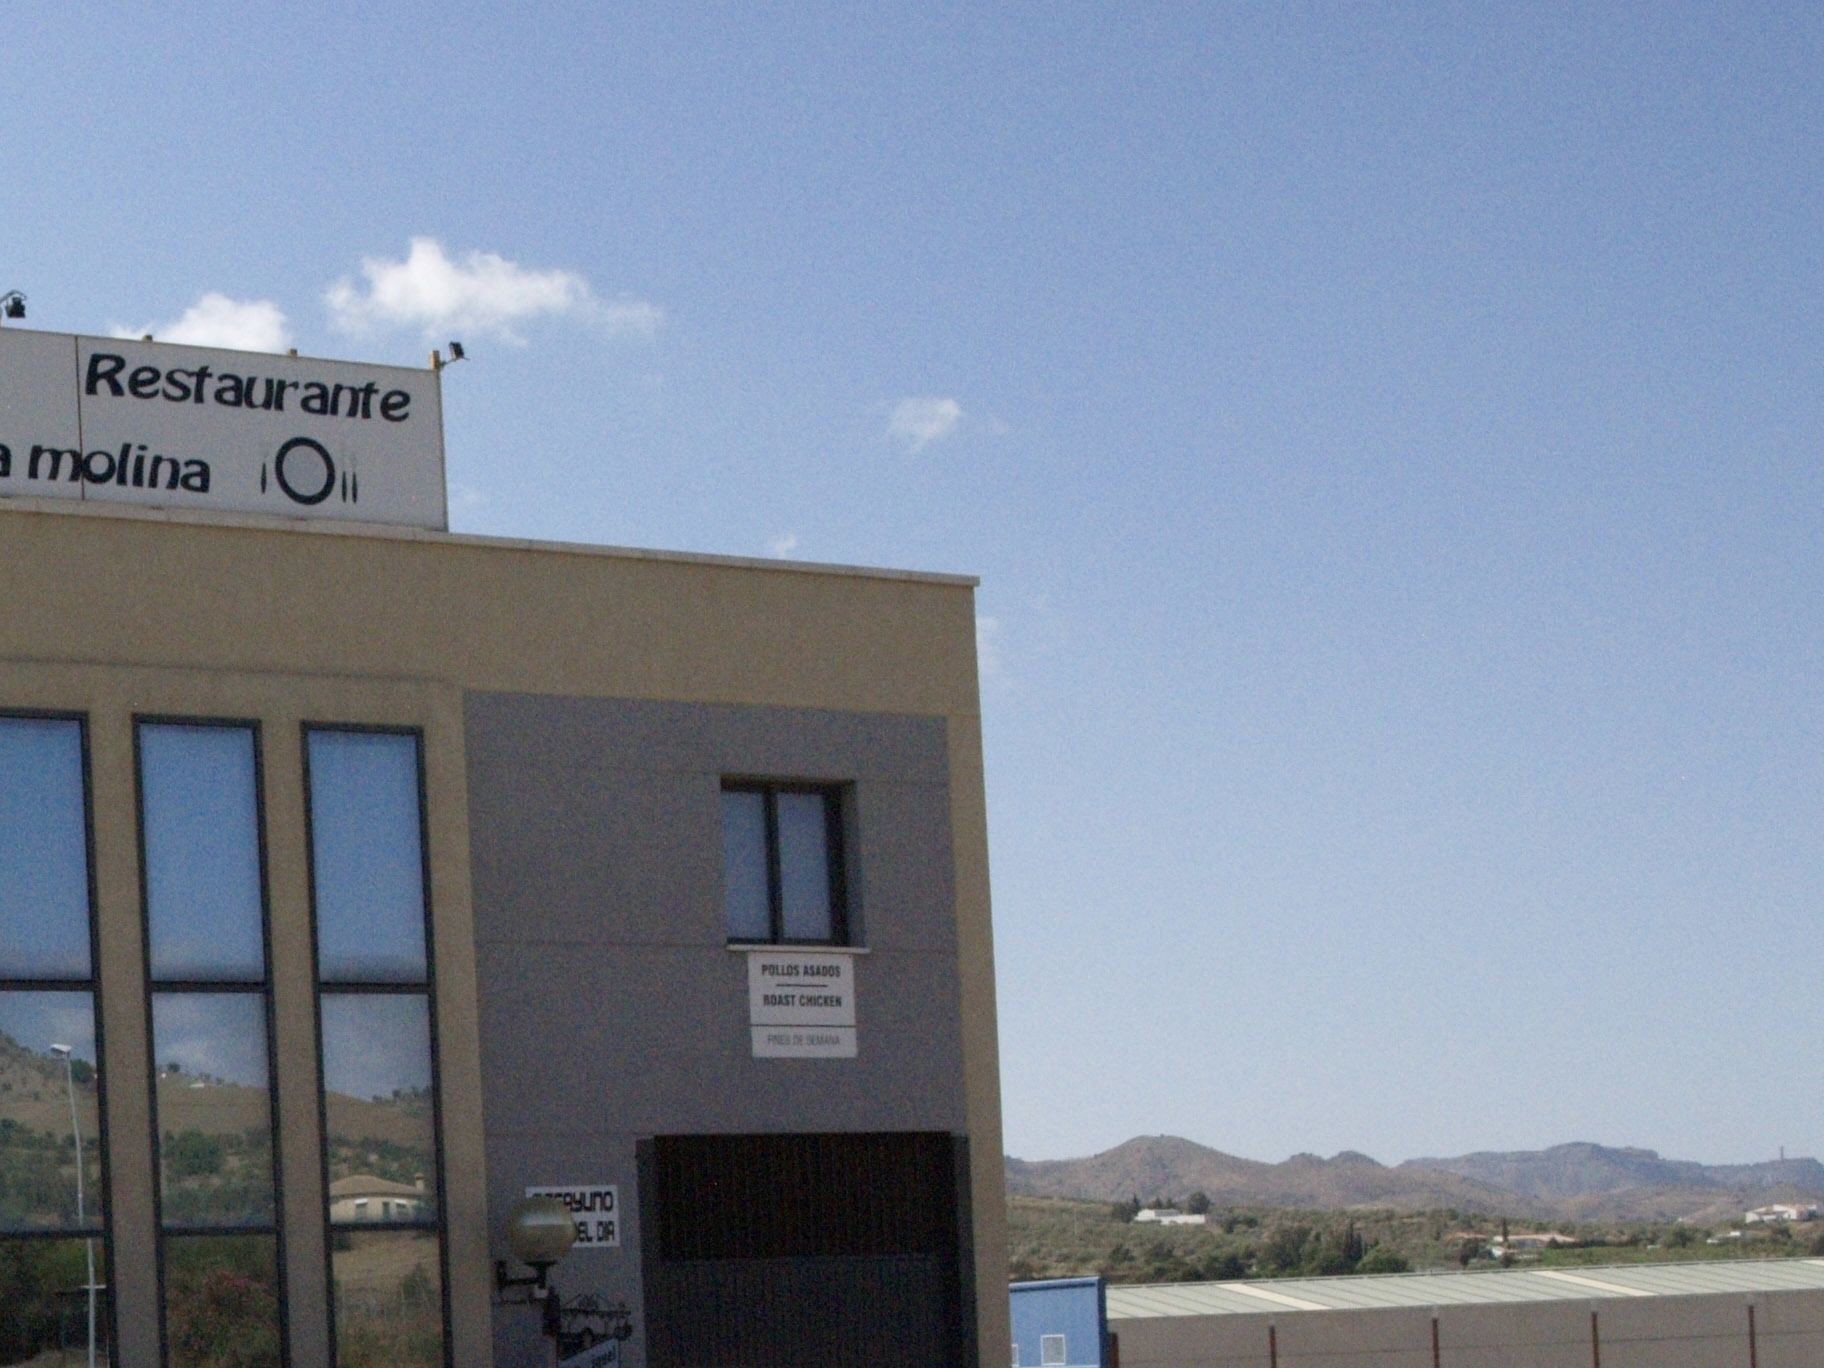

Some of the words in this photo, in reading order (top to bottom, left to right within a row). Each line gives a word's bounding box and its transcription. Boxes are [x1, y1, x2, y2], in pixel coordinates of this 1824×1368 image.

[85, 353, 411, 422] Restaurante
[28, 441, 211, 494] molina
[761, 963, 800, 977] POLLOS
[803, 964, 841, 978] ASADOS
[763, 994, 796, 1007] ROAST
[799, 994, 842, 1008] CHICKEN
[533, 1191, 614, 1213] AYUNO
[597, 1220, 615, 1242] DIA
